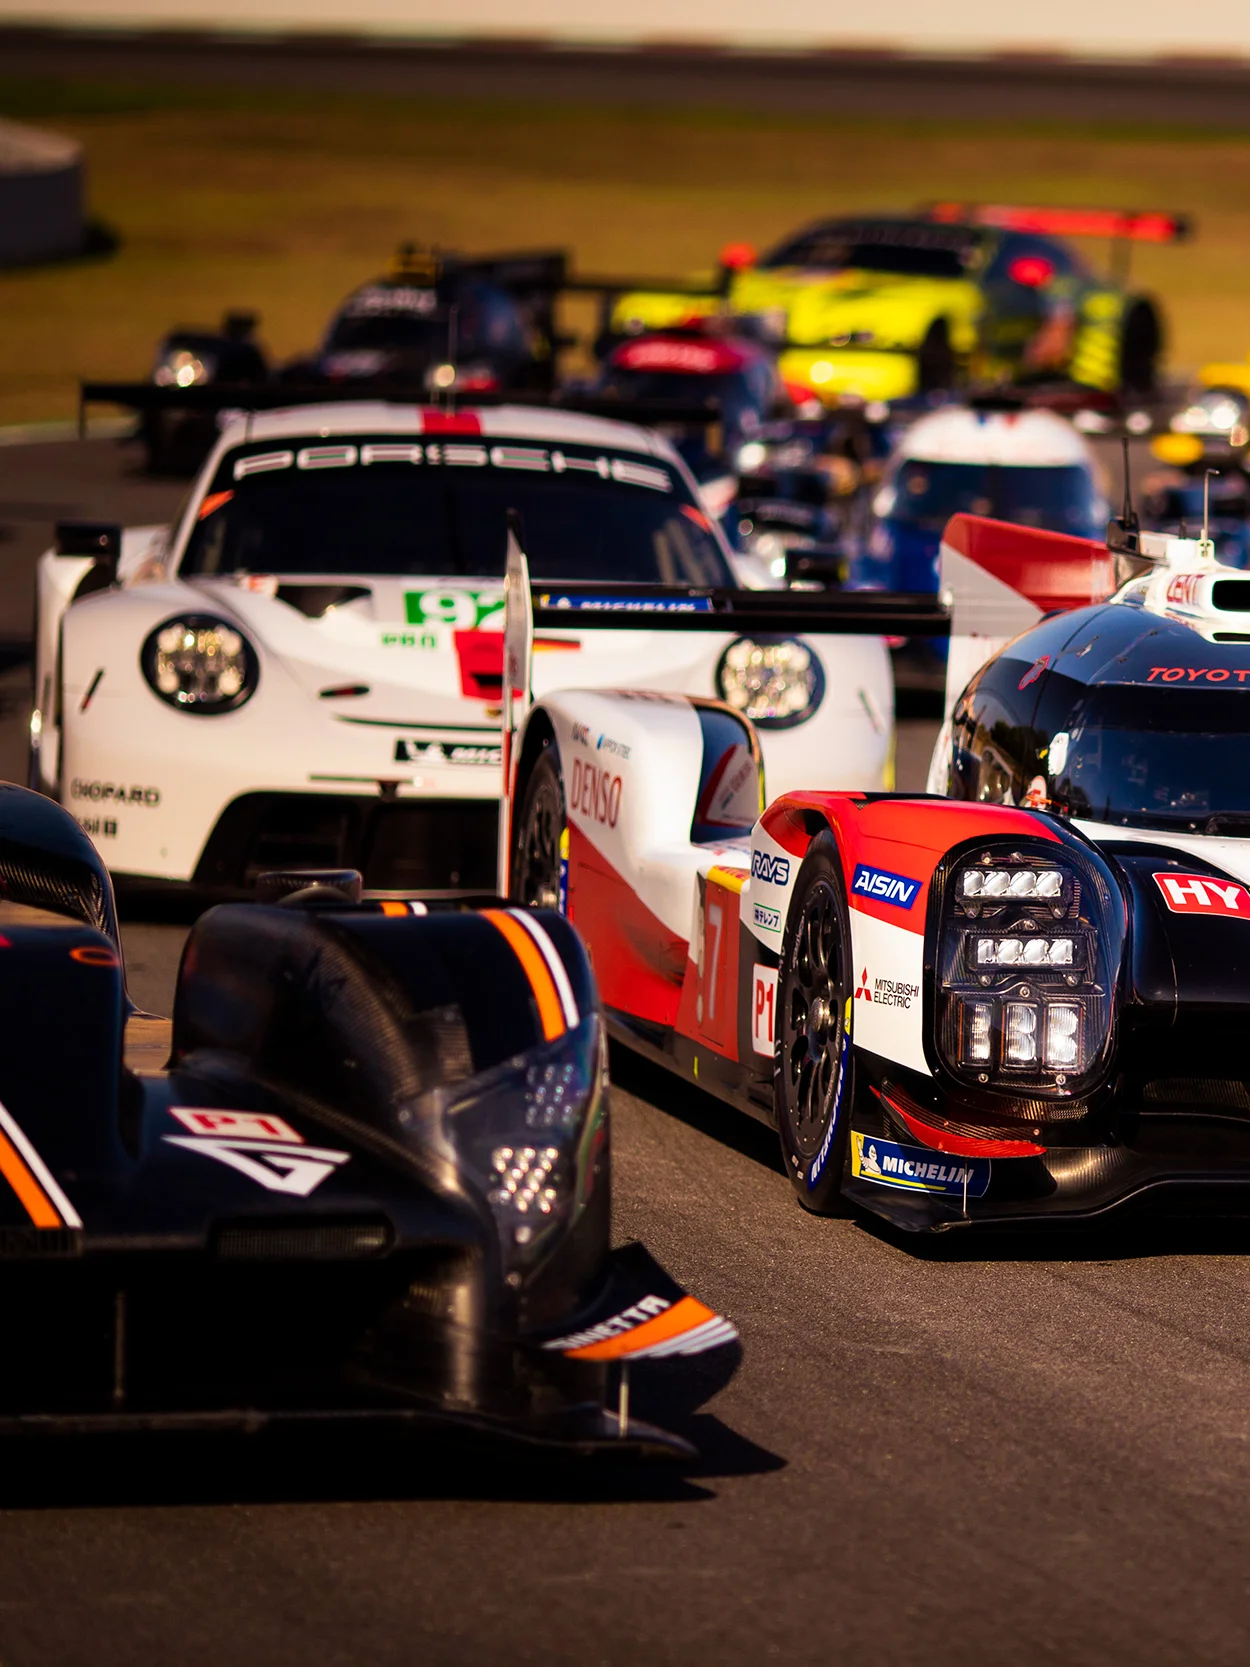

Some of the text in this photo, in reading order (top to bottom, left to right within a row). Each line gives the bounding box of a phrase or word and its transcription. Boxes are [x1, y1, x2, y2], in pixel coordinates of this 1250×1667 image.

[233, 444, 673, 493] PORSCHE
[571, 757, 622, 829] DENSO
[751, 850, 790, 886] RAYS
[854, 870, 914, 902] AISIN
[1163, 879, 1240, 909] HY
[709, 903, 722, 1021] 7
[874, 991, 911, 1009] ELECTRIC
[875, 978, 920, 997] MITSUBISHI
[756, 979, 775, 1042] P1
[191, 1113, 283, 1136] P1
[882, 1155, 974, 1184] MICHELIN
